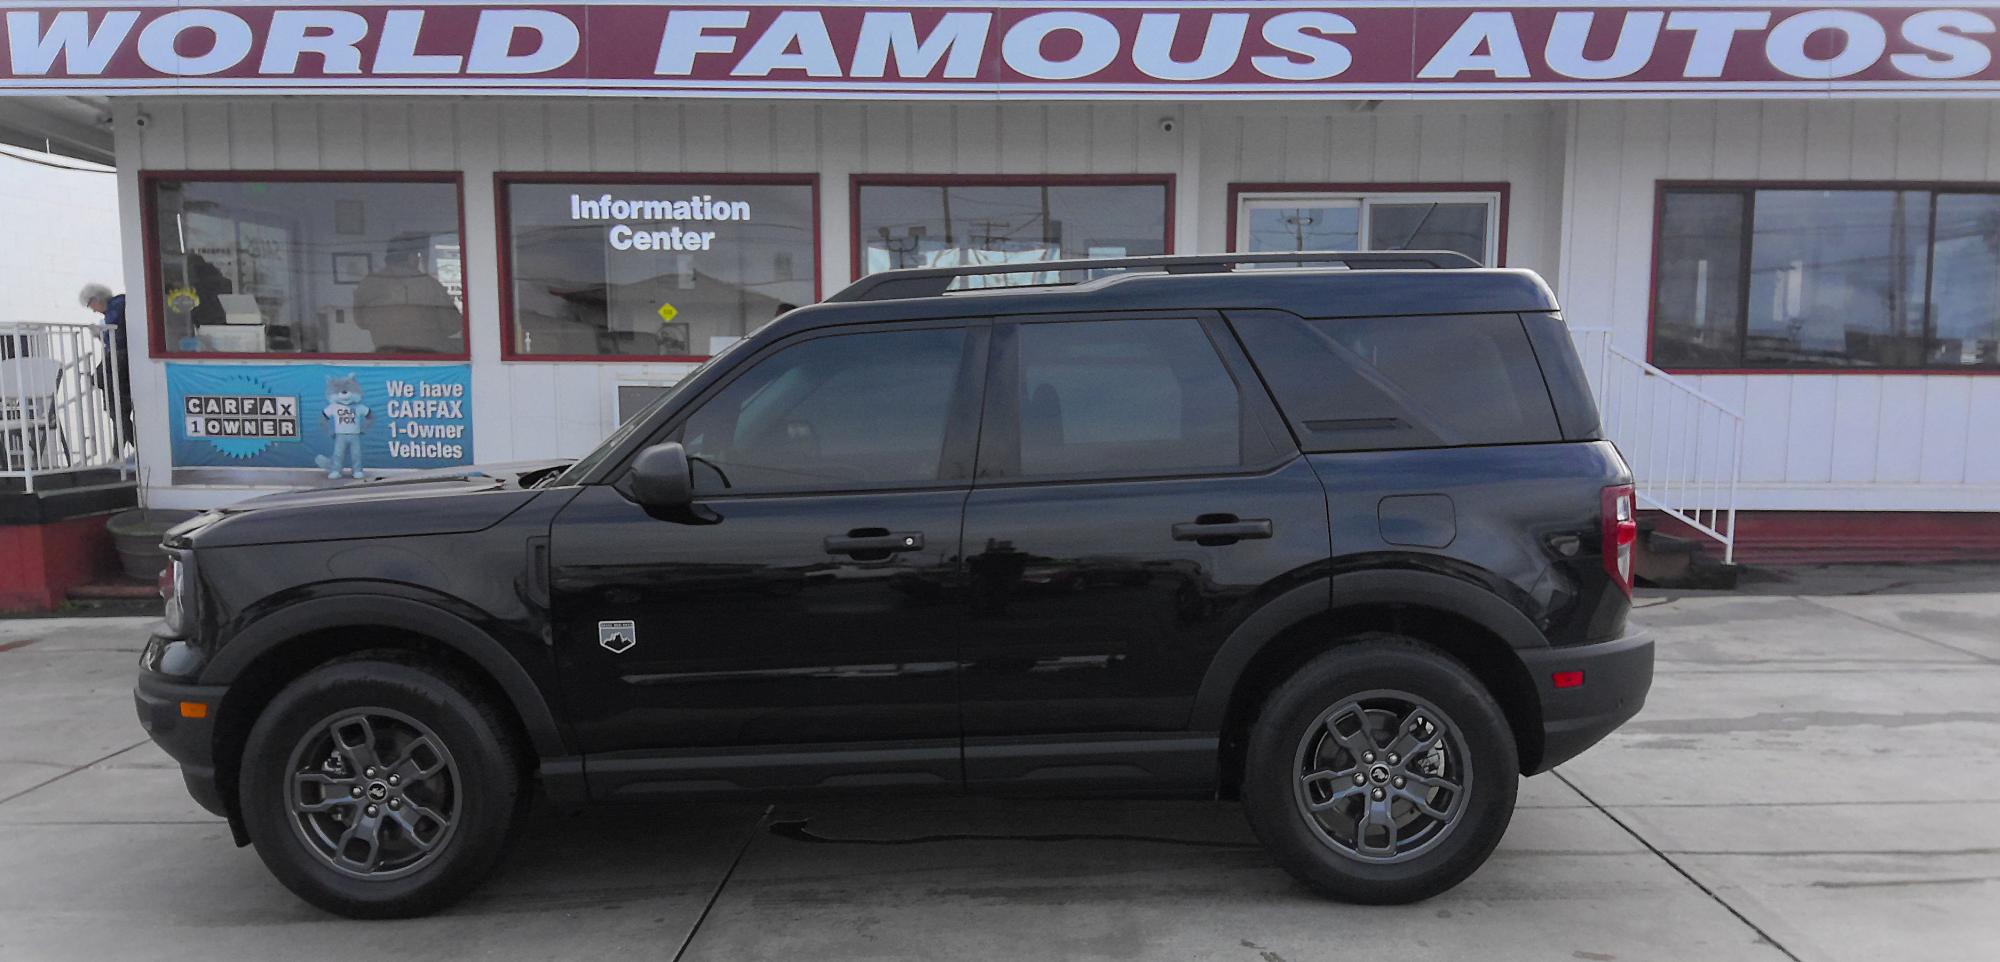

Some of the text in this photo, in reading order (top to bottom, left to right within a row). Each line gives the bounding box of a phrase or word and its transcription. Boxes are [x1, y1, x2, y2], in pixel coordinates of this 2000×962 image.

[6, 9, 1997, 80] WORLD FAMOUS AUTOS
[571, 194, 751, 221] Information
[609, 224, 716, 251] Center
[386, 380, 464, 398] We have
[187, 398, 293, 416] CARFAX
[387, 400, 464, 419] CARFAX
[190, 419, 295, 435] 1 OWNER
[338, 416, 356, 425] FOX
[388, 420, 465, 439] 1-Owner
[388, 440, 464, 459] Vehicles
